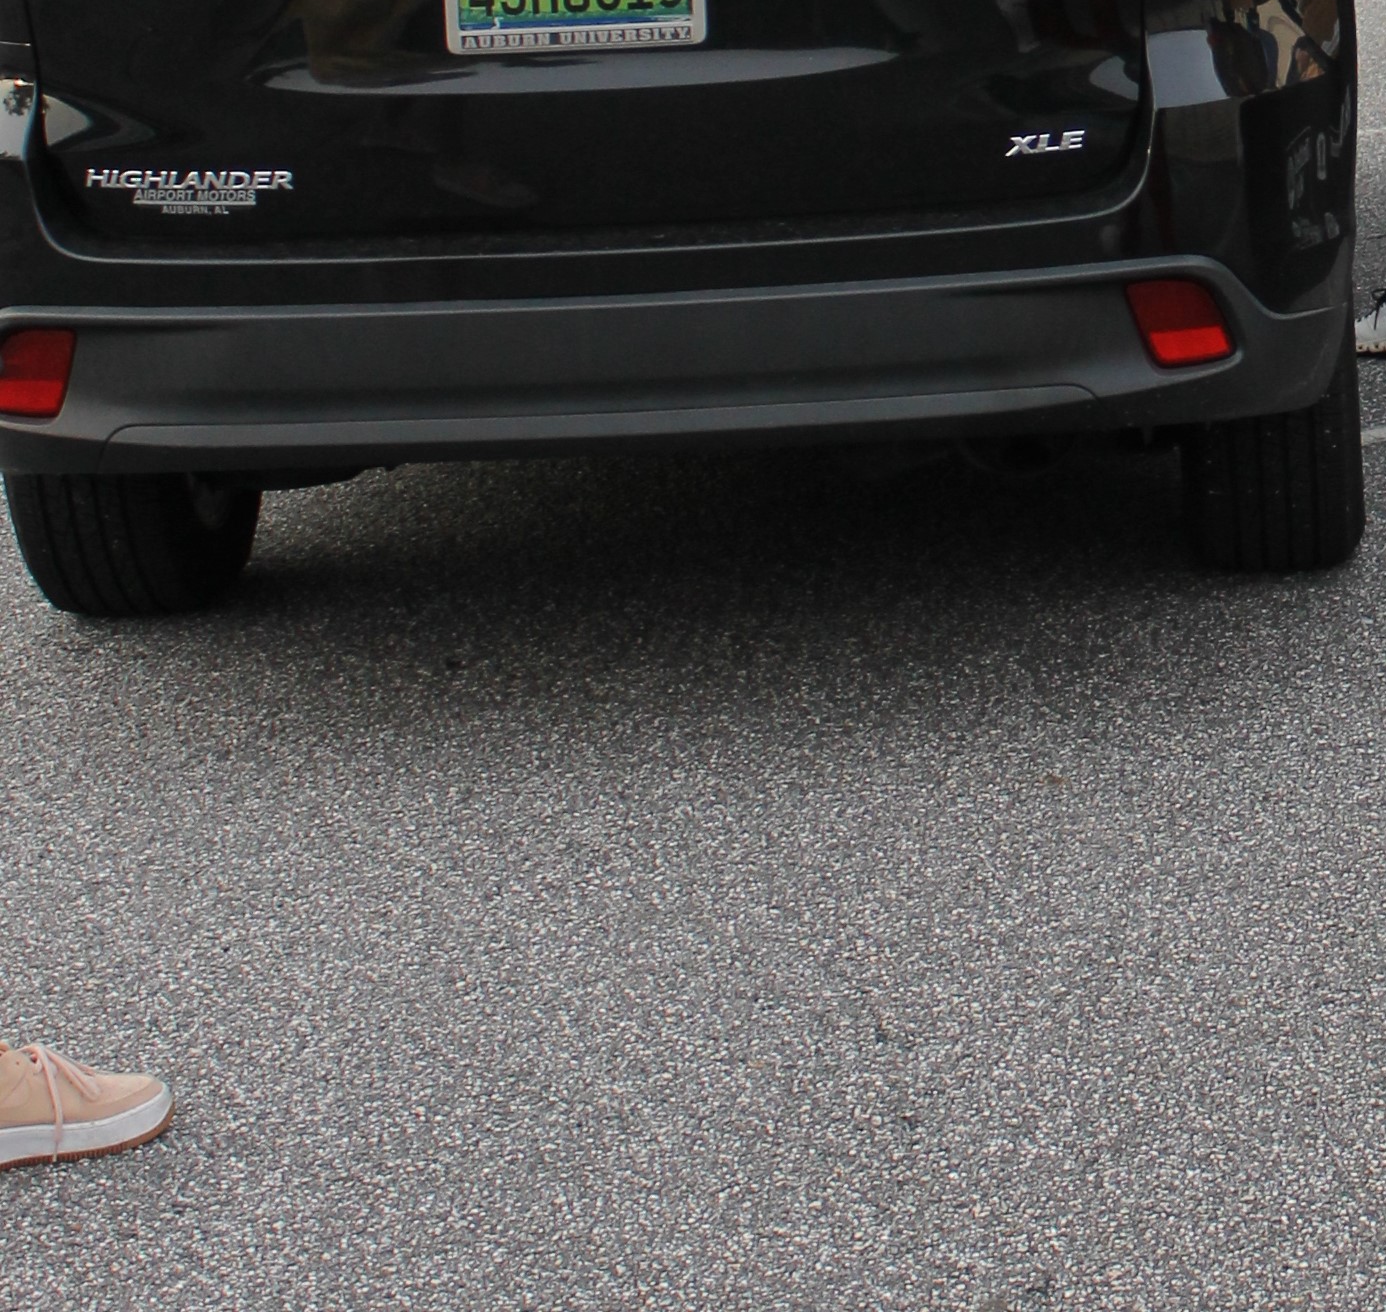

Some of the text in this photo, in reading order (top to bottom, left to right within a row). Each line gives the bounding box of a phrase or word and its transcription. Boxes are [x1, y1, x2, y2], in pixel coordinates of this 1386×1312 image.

[463, 26, 690, 50] AUBURN UNIVERSITY
[1005, 130, 1085, 157] XLE
[86, 168, 294, 189] HIGHLANDER
[134, 190, 256, 203] AIRPORT MOTORS
[215, 205, 230, 215] AL
